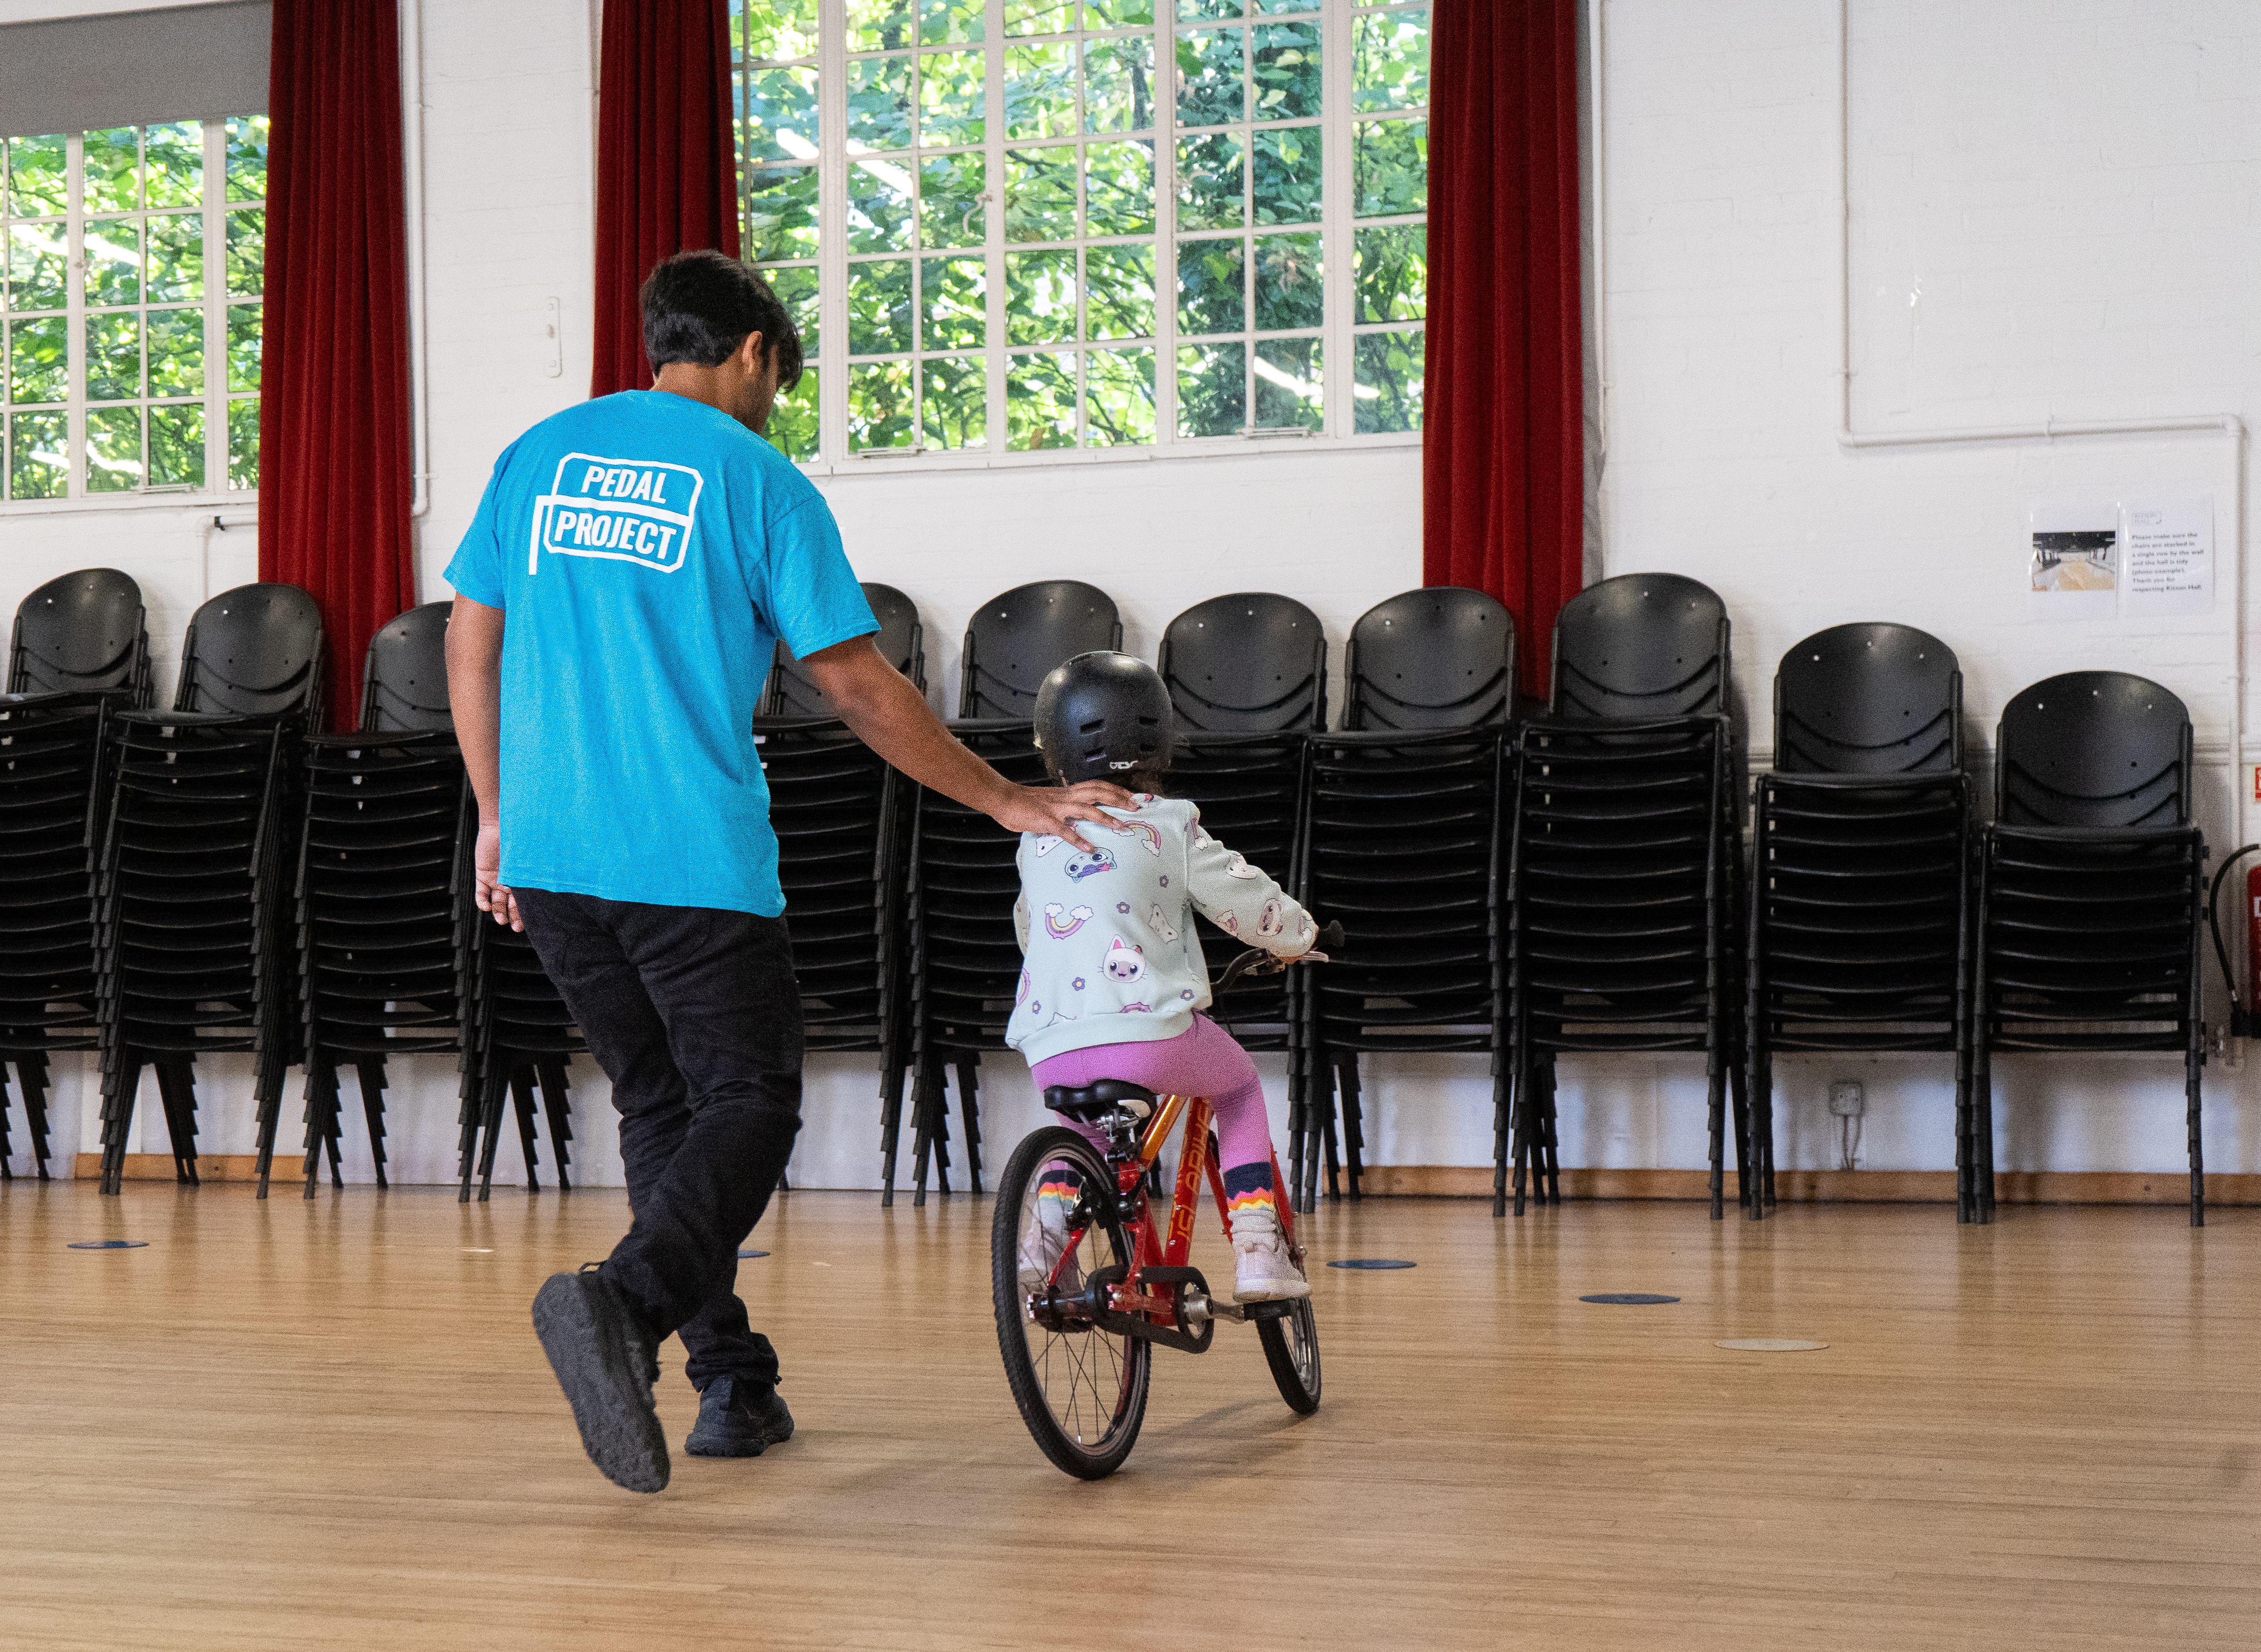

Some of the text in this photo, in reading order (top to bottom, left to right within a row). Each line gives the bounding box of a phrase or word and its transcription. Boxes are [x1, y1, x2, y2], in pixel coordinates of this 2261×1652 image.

[580, 465, 667, 504] PEDAL
[554, 510, 677, 559] PROJECT
[1177, 1098, 1210, 1242] ISLABIKE
